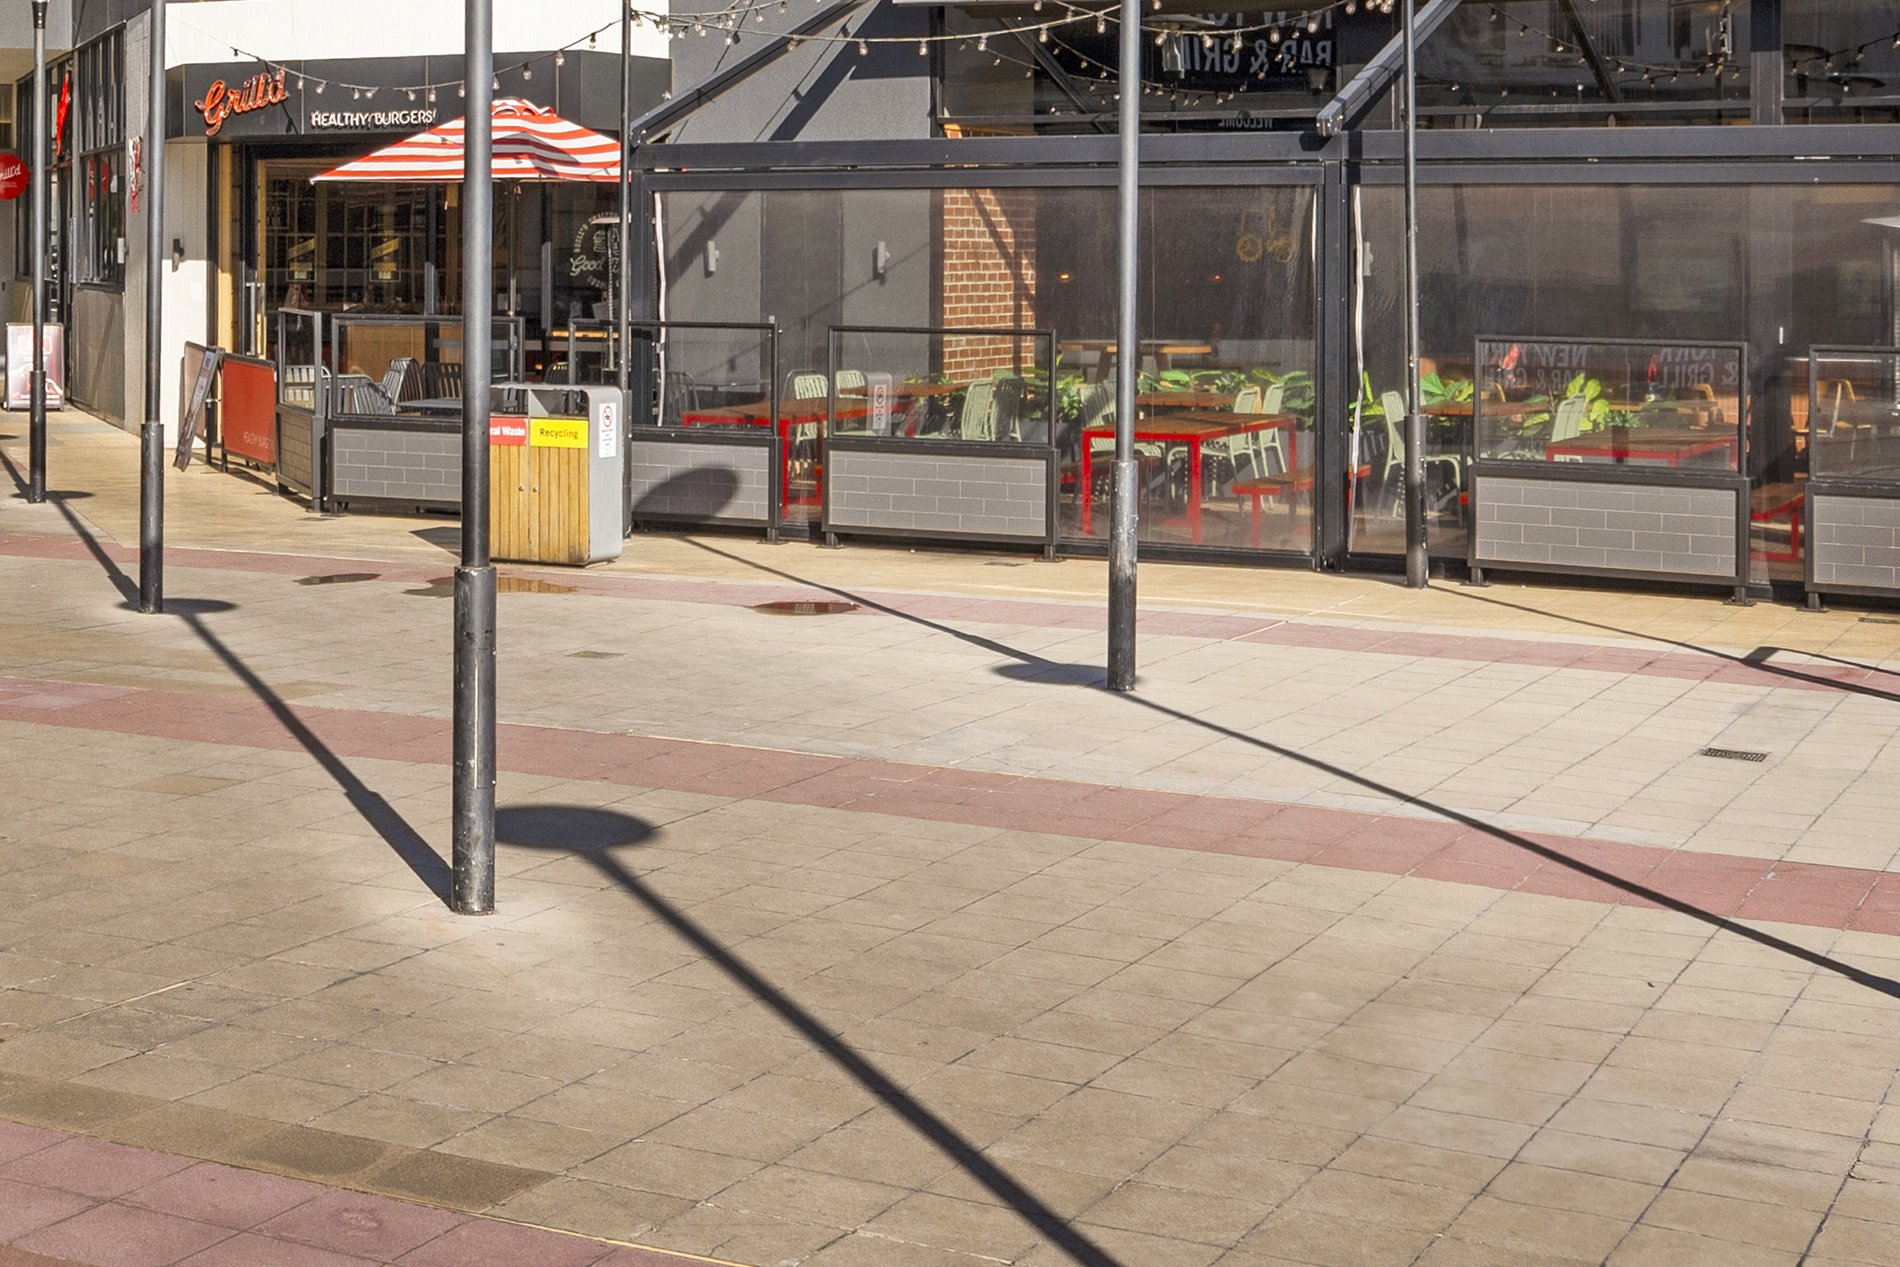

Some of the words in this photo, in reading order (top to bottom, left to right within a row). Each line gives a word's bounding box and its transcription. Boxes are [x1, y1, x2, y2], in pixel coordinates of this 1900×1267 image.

[194, 66, 289, 136] Grill'd
[311, 112, 369, 127] HEALTHY
[374, 110, 433, 126] BURGERS
[570, 254, 605, 276] Good
[502, 427, 526, 437] Waste
[540, 428, 579, 440] Recycling
